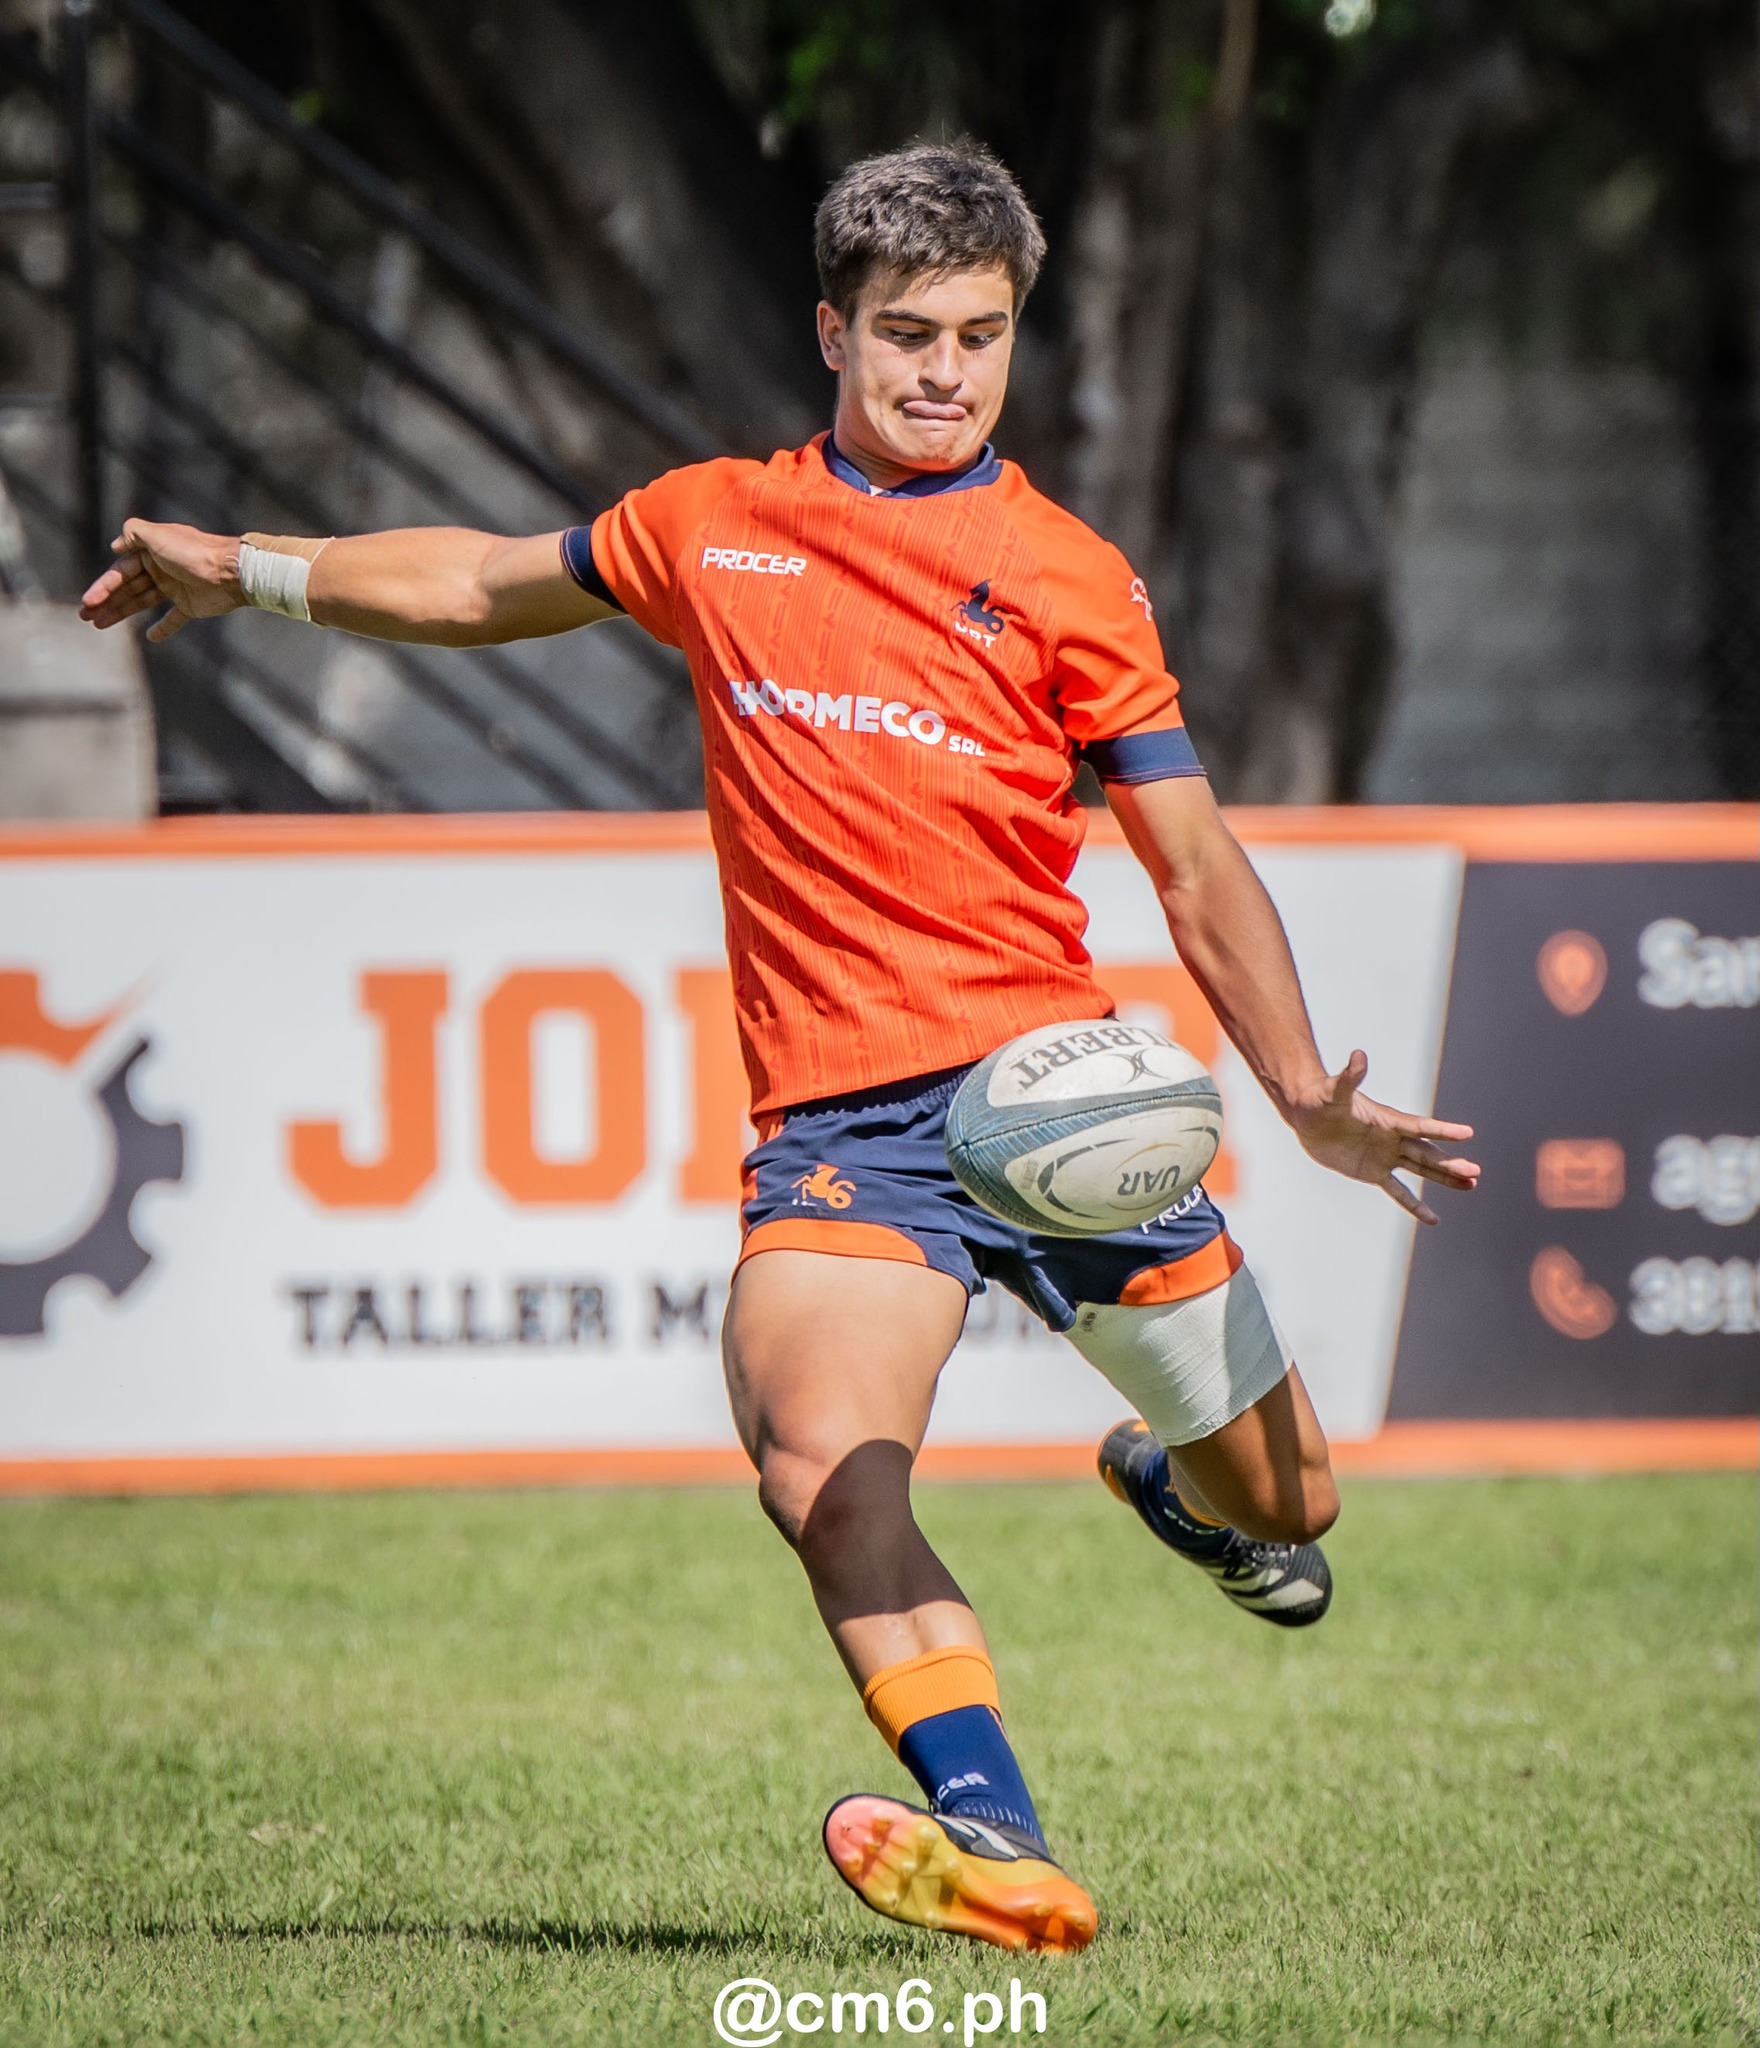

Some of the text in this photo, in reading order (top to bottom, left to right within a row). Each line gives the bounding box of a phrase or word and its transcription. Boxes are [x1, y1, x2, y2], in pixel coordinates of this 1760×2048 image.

[701, 547, 807, 576] PROCER
[729, 679, 986, 757] HORMECO SRL
[1117, 1165, 1181, 1196] UAR
[284, 1282, 614, 1349] TALLER
[1629, 1256, 1760, 1335] 381
